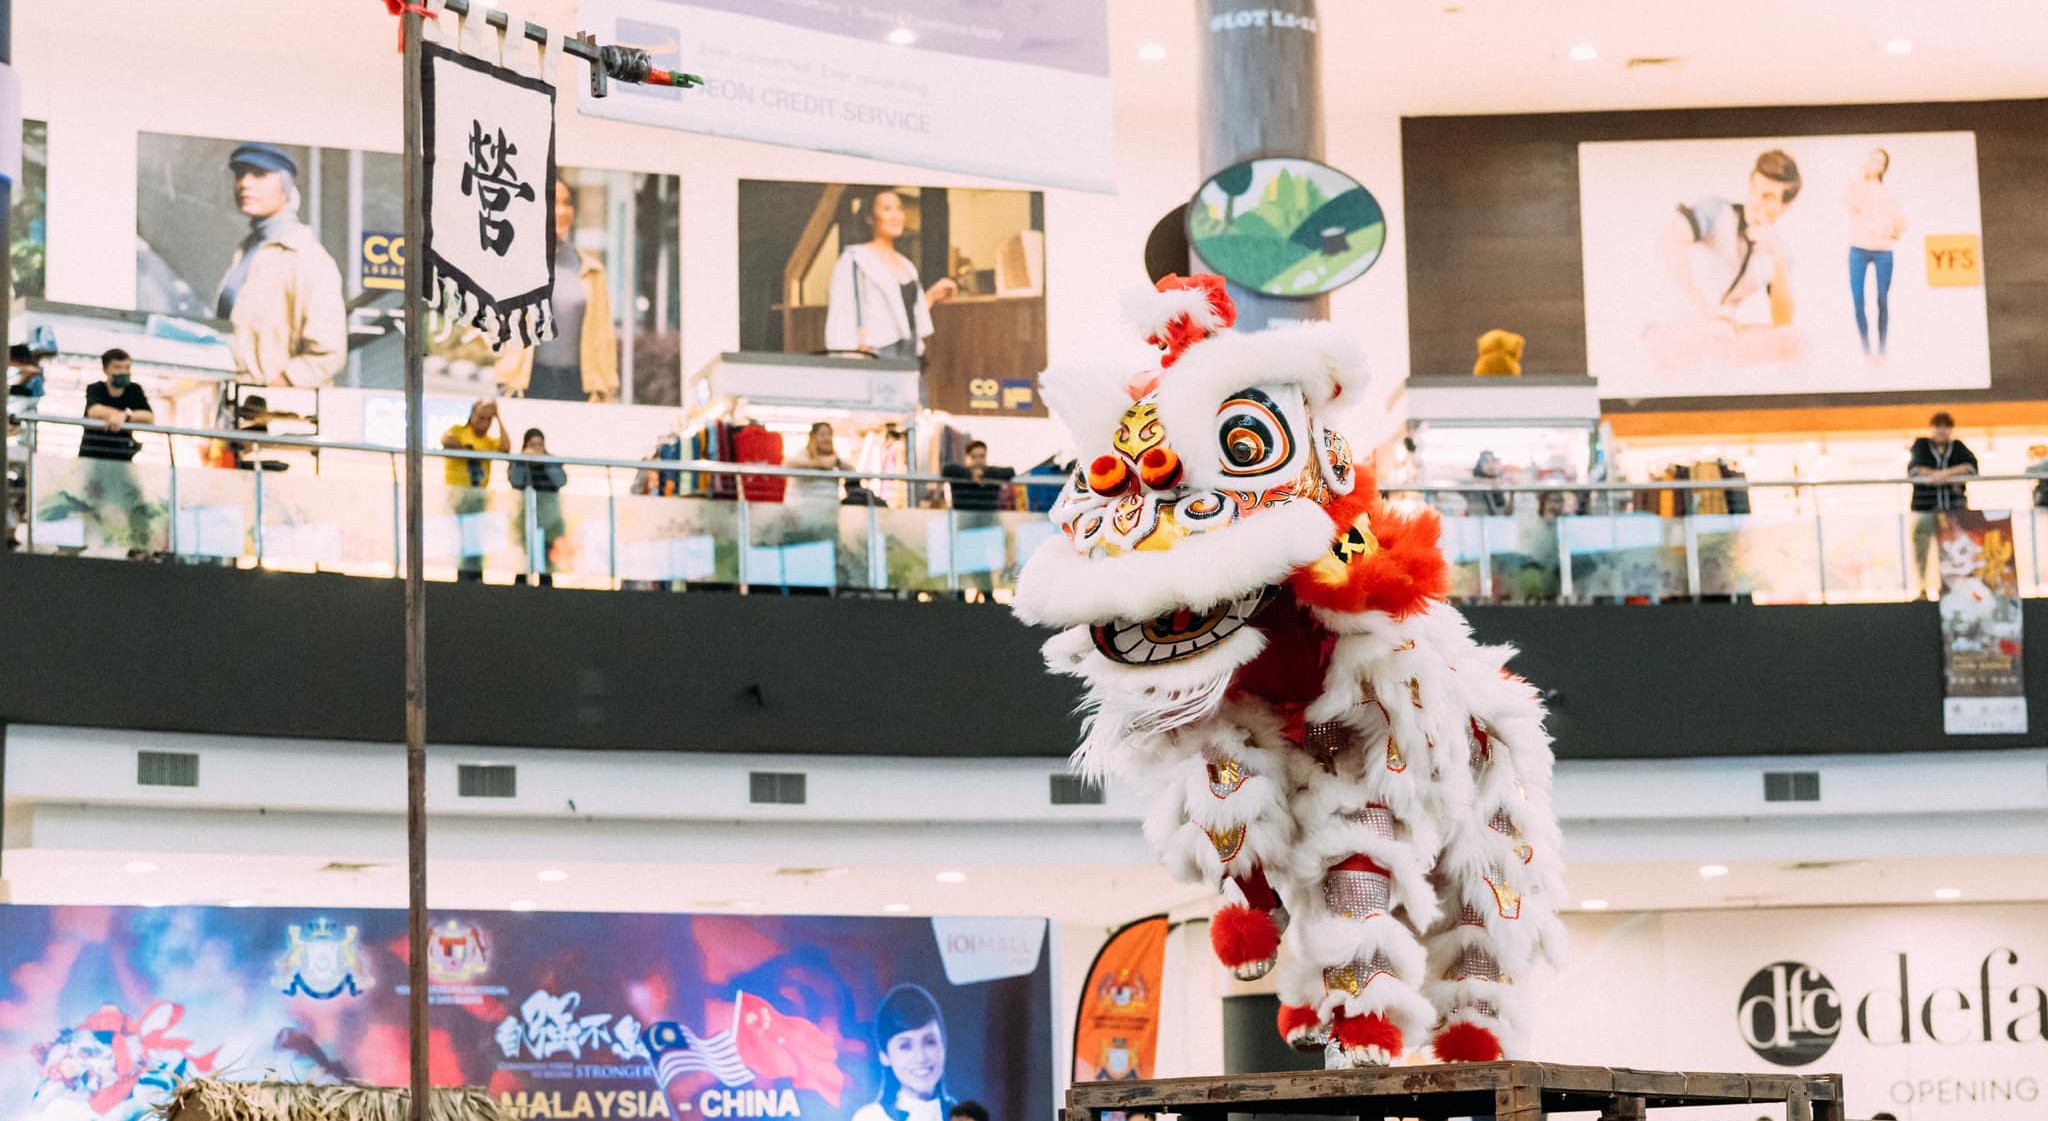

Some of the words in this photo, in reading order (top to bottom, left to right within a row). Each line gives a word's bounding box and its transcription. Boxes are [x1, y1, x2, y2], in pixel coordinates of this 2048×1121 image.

[760, 87, 834, 118] CREDIT
[841, 100, 932, 134] SERVICE
[1929, 247, 1975, 271] YFS
[499, 1090, 671, 1120] MALAYSIA
[700, 1088, 801, 1119] CHINA
[1890, 1076, 2040, 1105] OPENING
